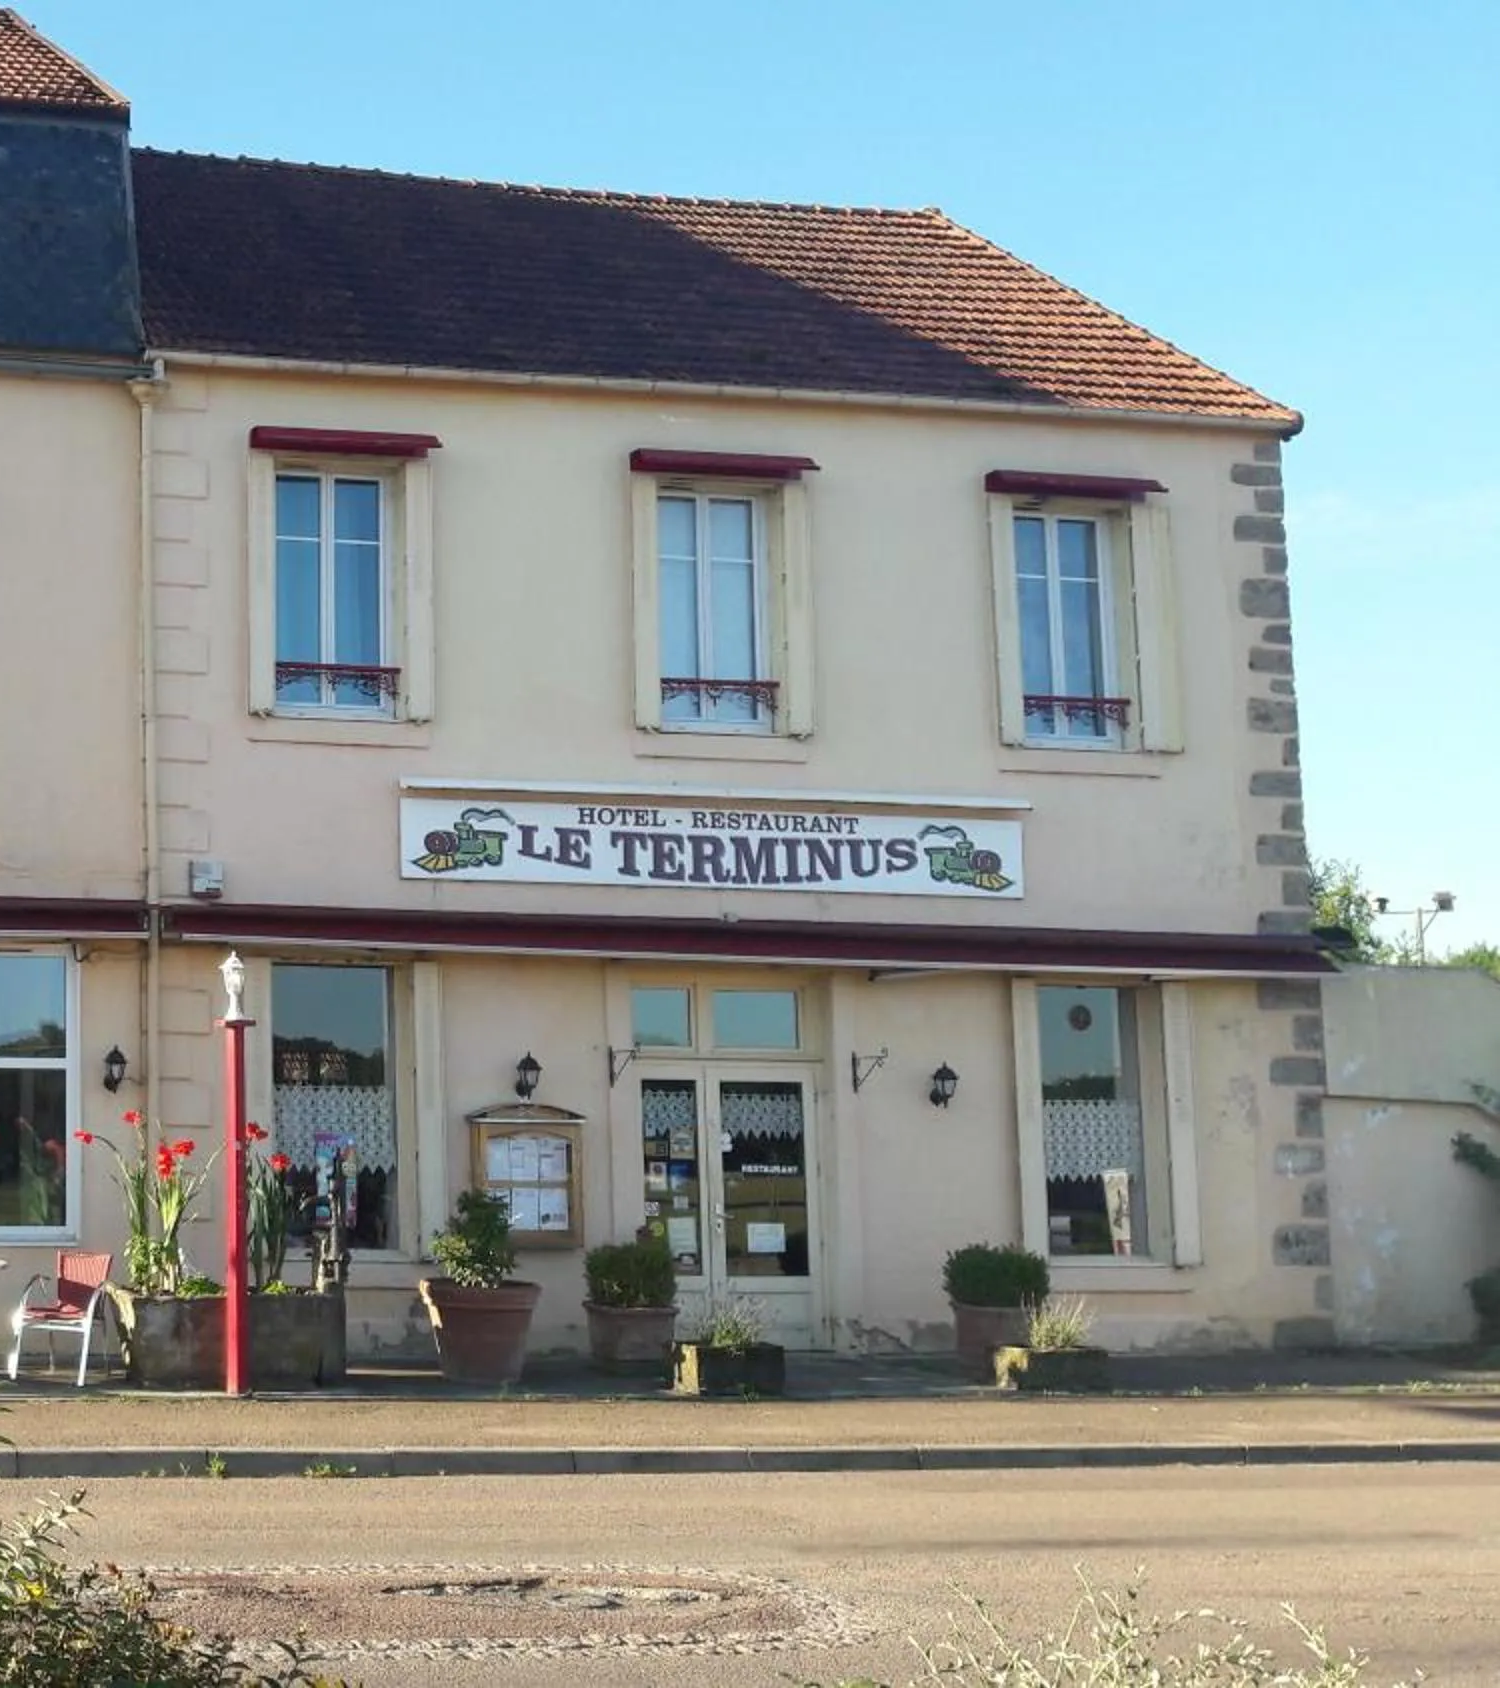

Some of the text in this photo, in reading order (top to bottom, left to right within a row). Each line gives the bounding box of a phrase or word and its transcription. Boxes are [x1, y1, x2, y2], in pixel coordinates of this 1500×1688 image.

[577, 807, 667, 827] HOTEL
[691, 811, 859, 835] RESTAURANT
[516, 824, 919, 885] LE TERMINUS
